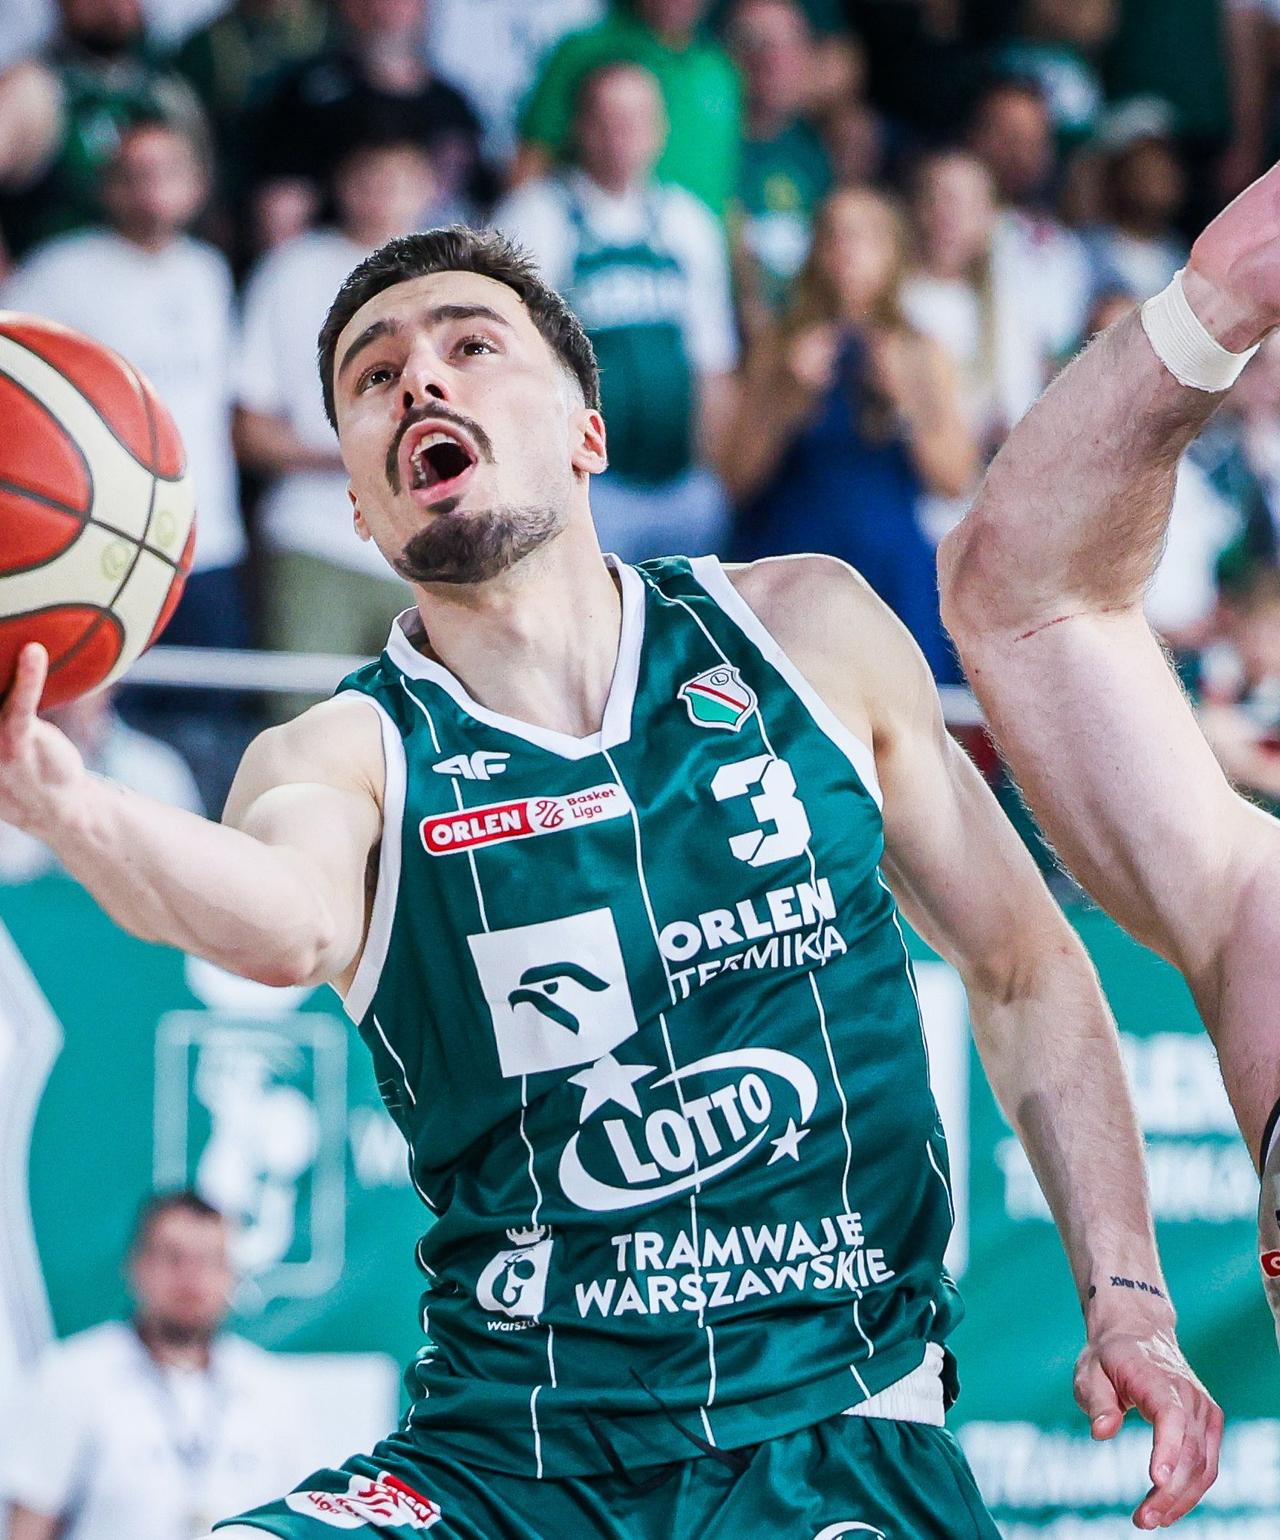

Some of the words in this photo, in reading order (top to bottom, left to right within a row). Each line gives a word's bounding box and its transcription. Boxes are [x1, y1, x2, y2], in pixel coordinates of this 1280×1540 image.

[431, 809, 523, 846] ORLEN
[566, 788, 616, 806] Basket
[571, 804, 603, 819] Liga
[710, 754, 812, 868] 3
[658, 877, 837, 962] ORLEN
[603, 1073, 771, 1184] LOTTO
[611, 1212, 865, 1273] TRAMWAJE
[575, 1248, 896, 1319] WARSZAWSKIE
